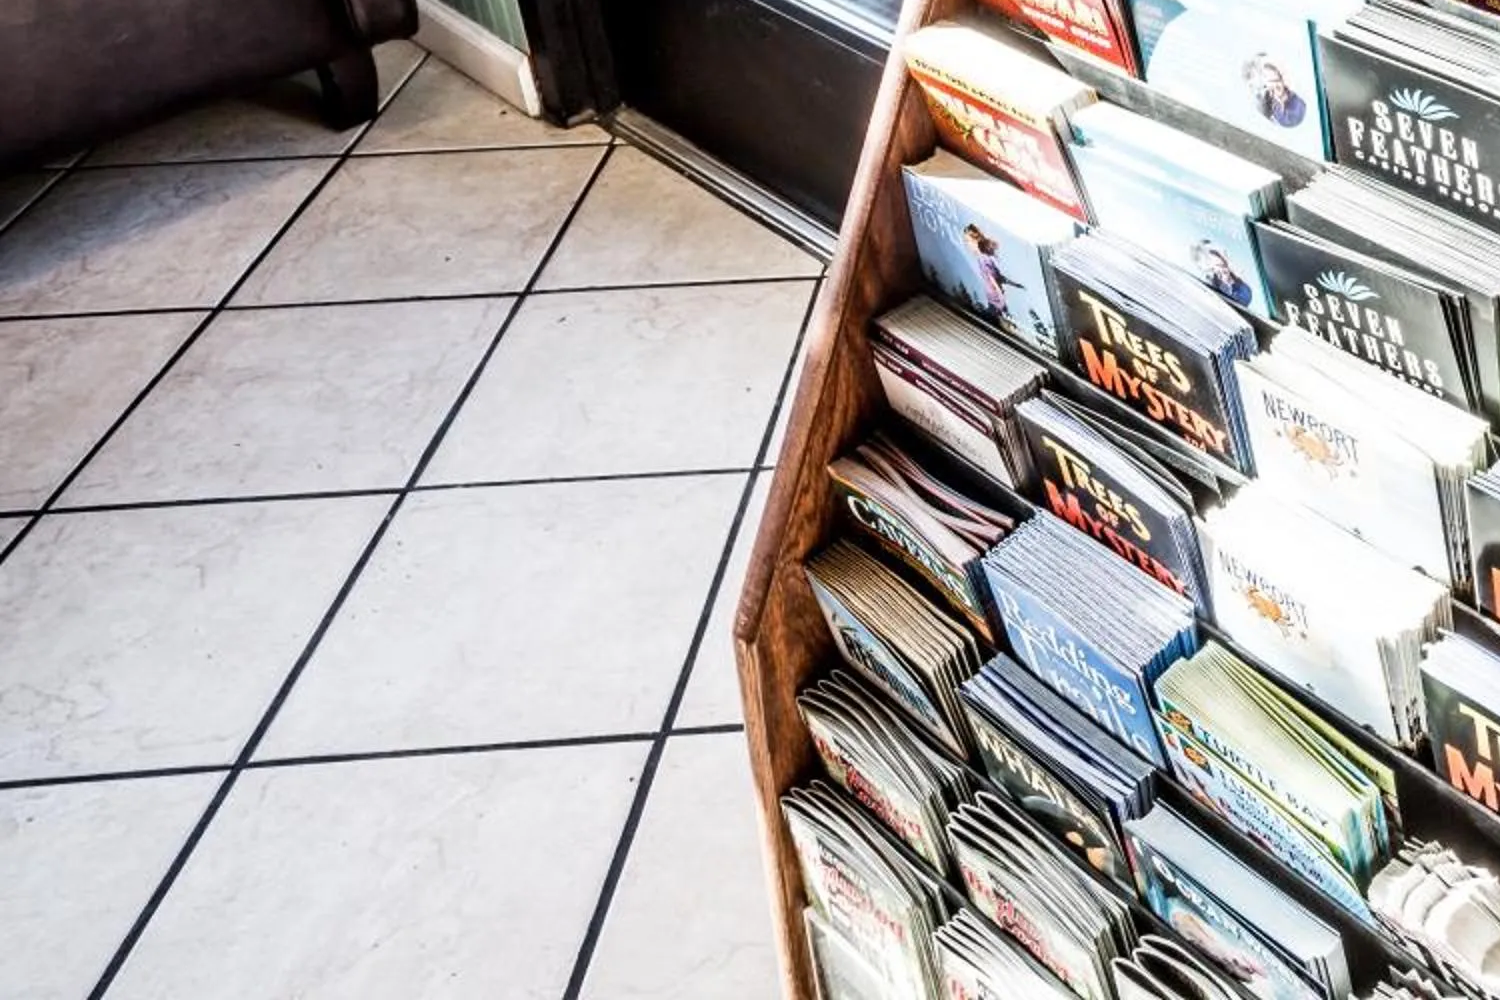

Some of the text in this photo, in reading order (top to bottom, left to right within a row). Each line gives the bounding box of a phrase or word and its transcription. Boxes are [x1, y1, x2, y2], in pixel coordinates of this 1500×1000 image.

[1371, 99, 1480, 170] SEVEN
[1078, 290, 1191, 393] TREES
[1261, 390, 1360, 465] NEWPORT
[1218, 551, 1309, 628] NEWPORT
